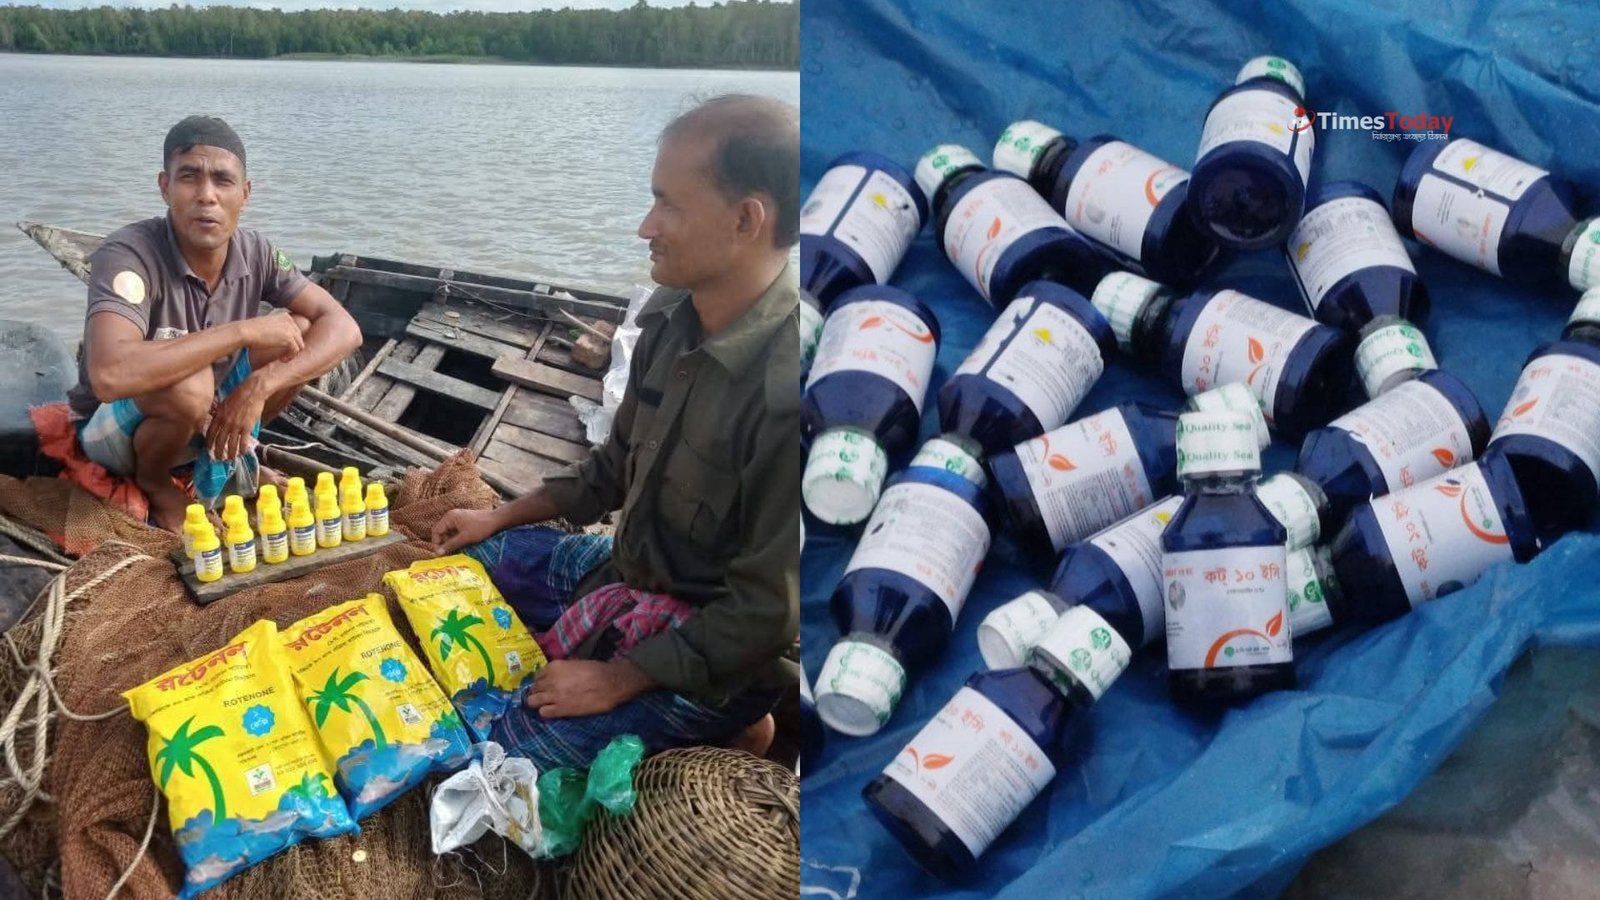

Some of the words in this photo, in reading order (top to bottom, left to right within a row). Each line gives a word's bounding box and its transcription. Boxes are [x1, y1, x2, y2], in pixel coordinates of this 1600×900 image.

[1185, 421, 1227, 433] Quality
[1187, 450, 1228, 462] Quality
[360, 640, 402, 660] ROTENONE
[223, 686, 276, 708] ROTENONE
